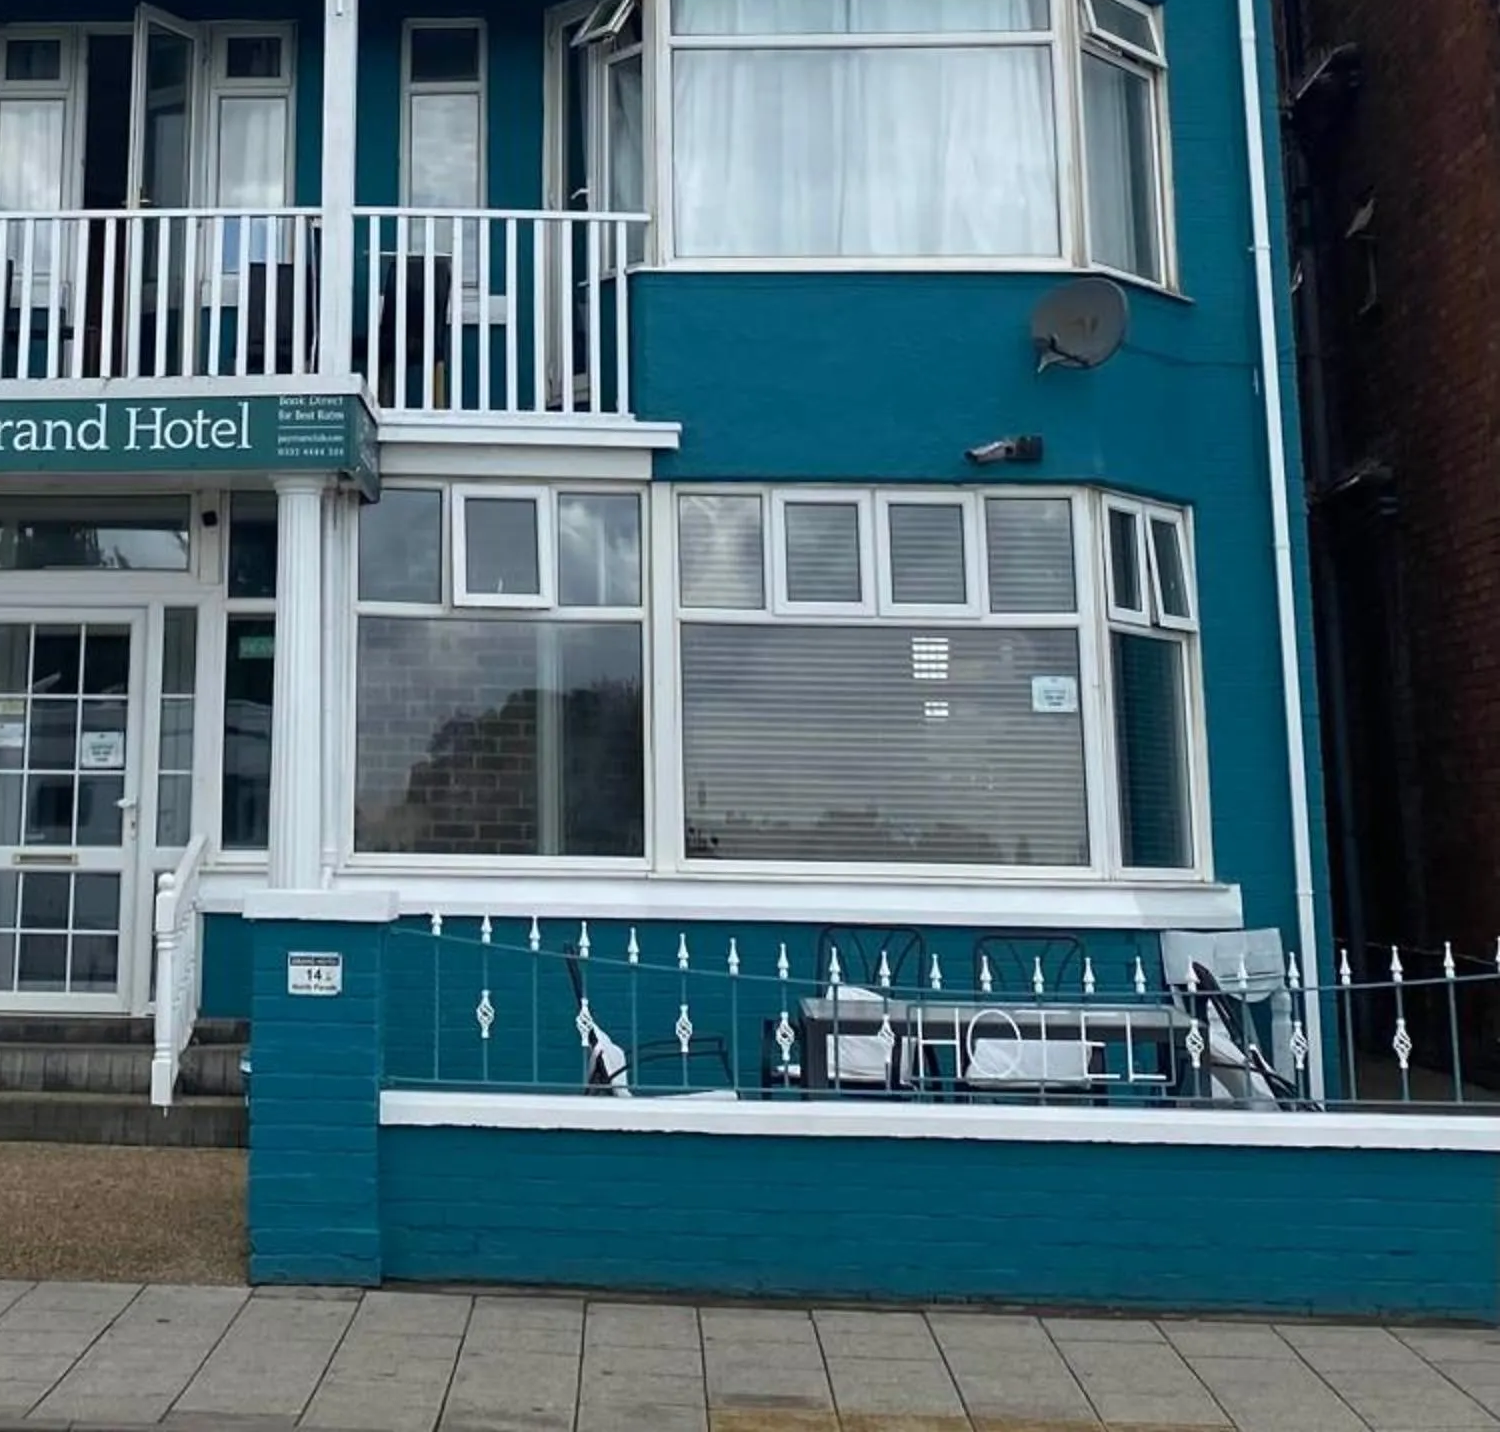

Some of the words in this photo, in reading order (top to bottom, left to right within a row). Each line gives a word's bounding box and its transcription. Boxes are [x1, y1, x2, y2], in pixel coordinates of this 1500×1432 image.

[124, 401, 252, 451] Hotel
[306, 969, 322, 981] 14
[917, 1008, 1167, 1082] HOTEL
